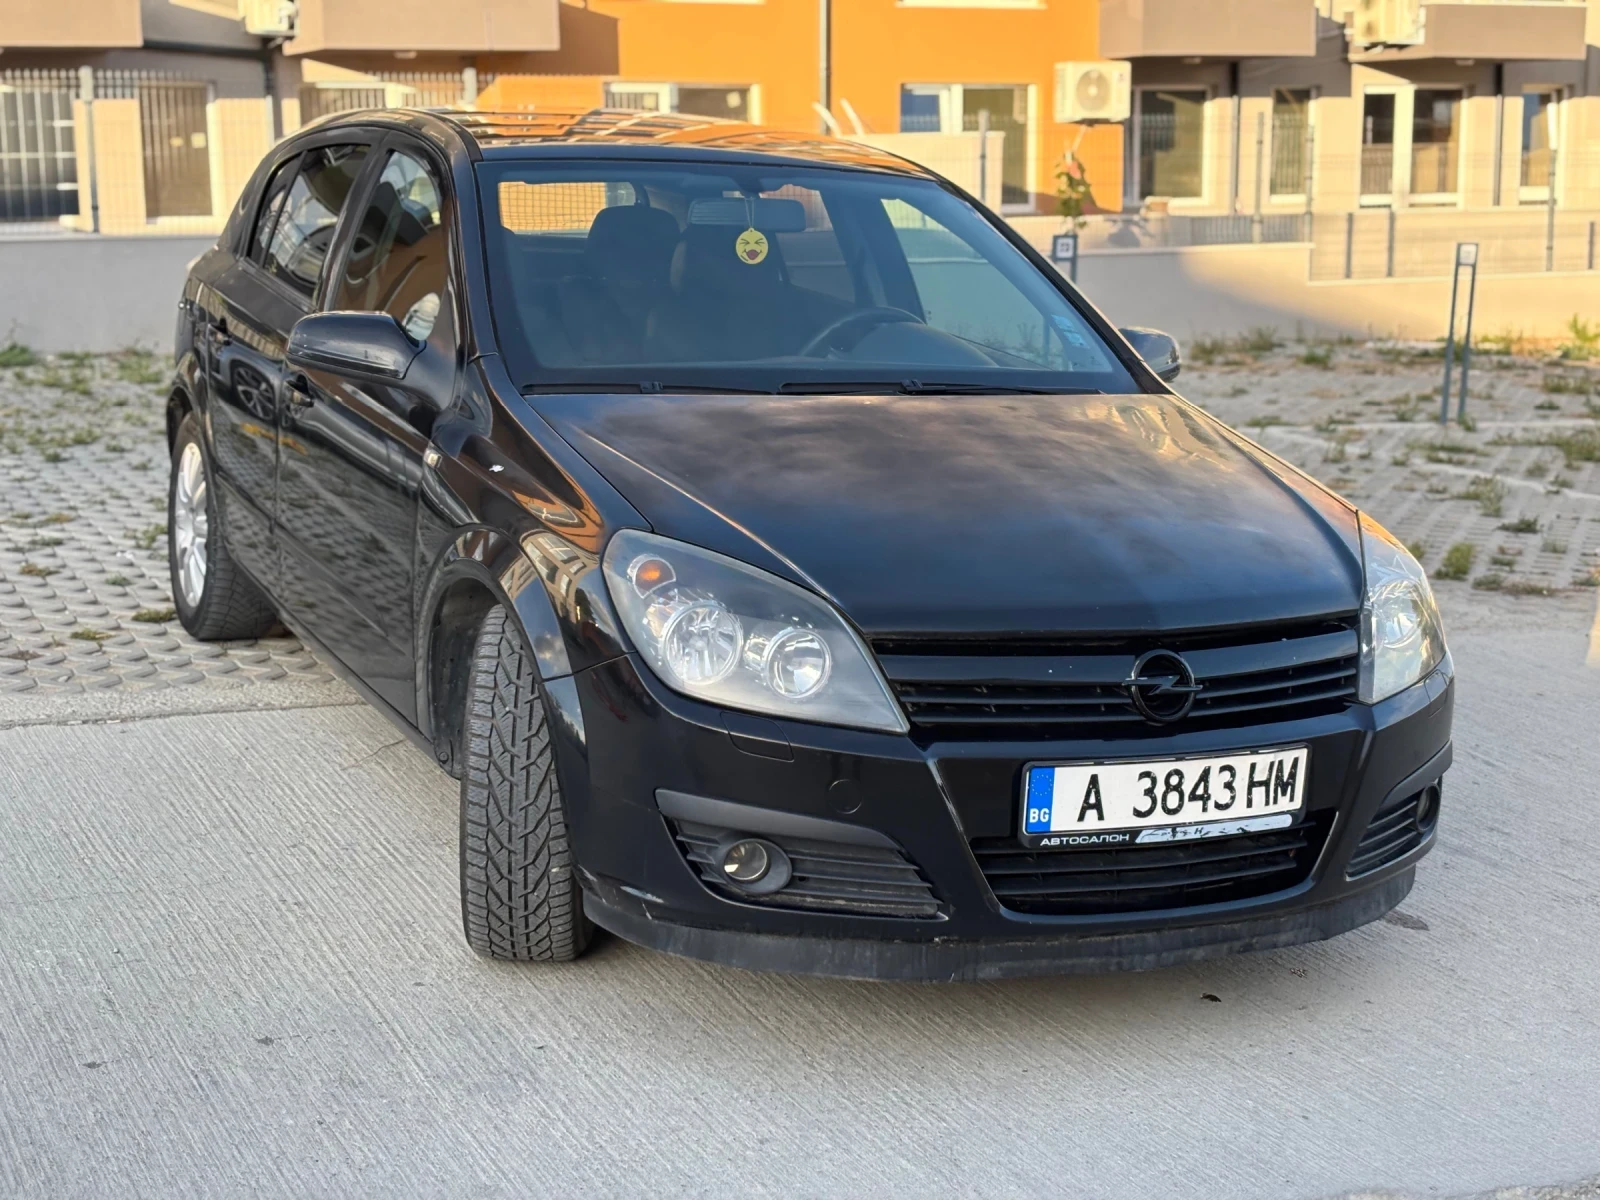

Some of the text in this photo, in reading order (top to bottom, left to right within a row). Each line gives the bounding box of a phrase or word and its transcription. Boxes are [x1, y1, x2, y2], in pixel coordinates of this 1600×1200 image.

[1077, 773, 1105, 823] A
[1132, 764, 1237, 819] 3843
[1029, 808, 1050, 823] BG
[1040, 833, 1130, 847] АВТОСАЛОН
